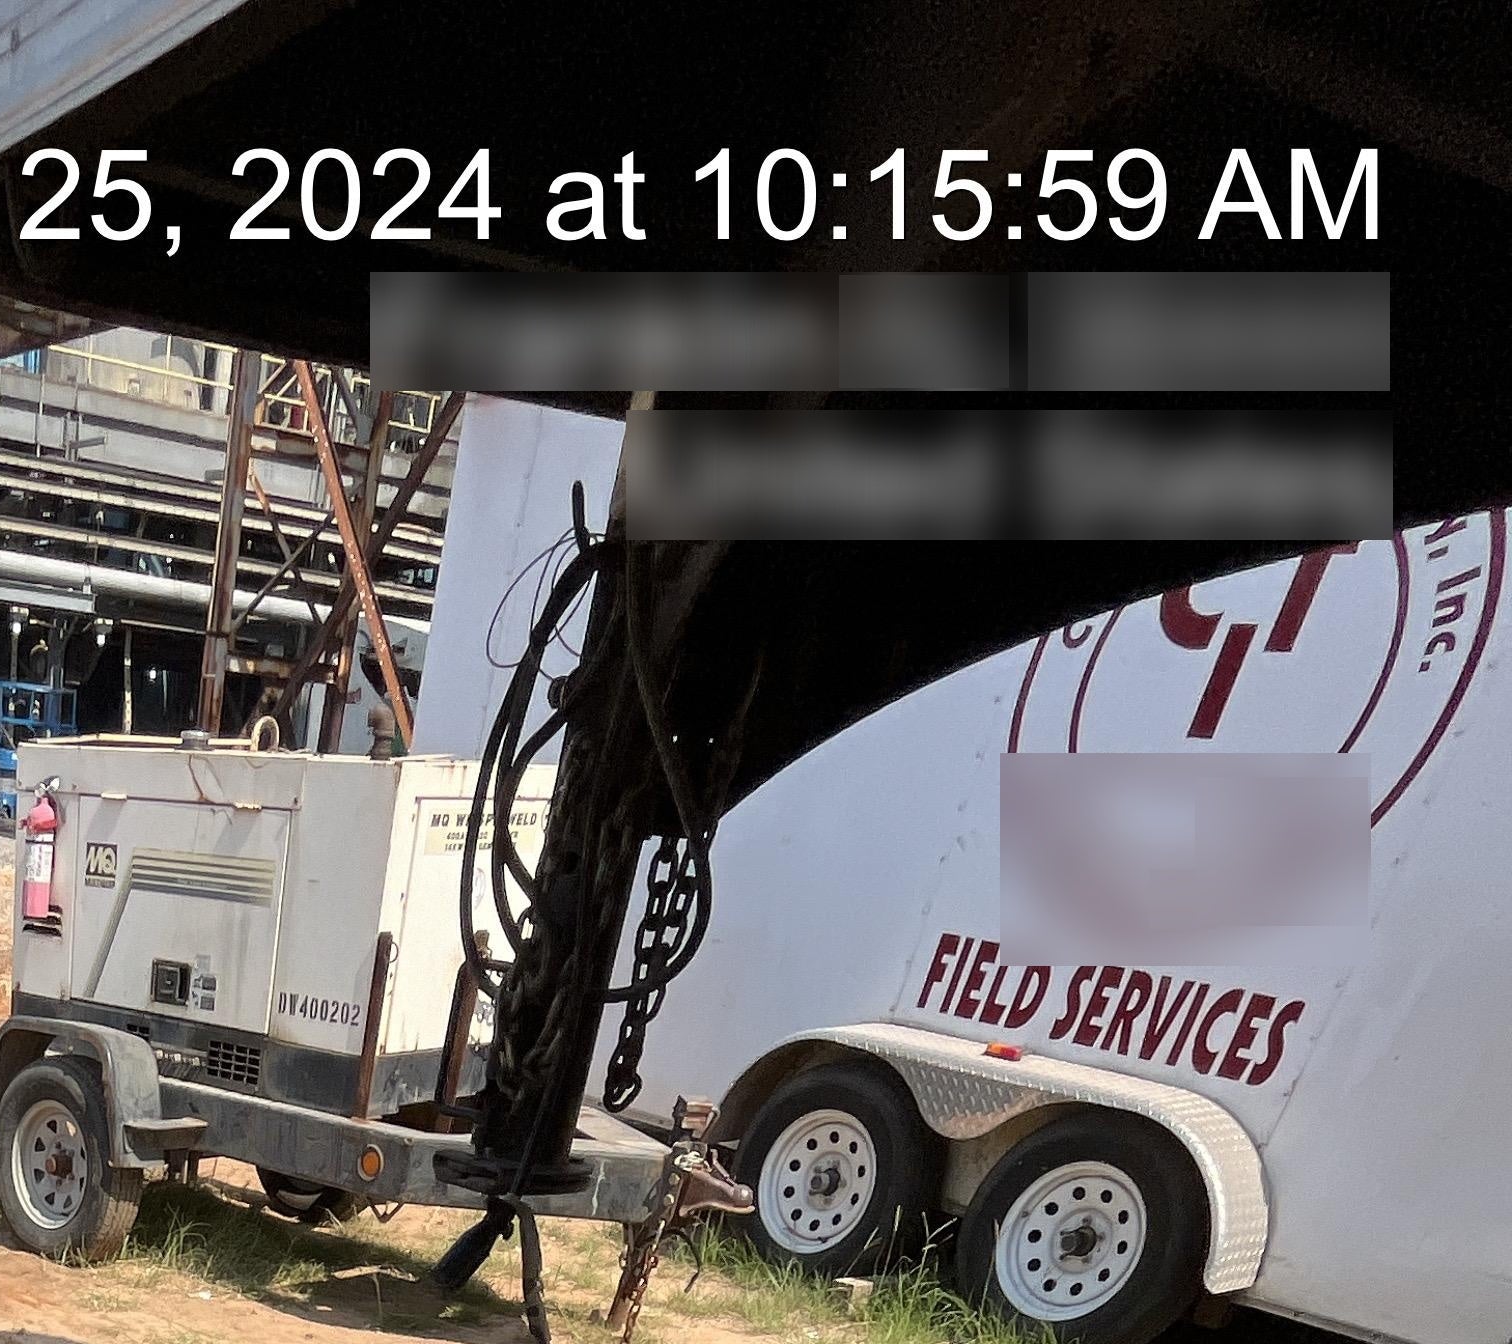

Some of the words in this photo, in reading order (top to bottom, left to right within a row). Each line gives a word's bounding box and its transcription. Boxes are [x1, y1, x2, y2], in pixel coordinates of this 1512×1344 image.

[1418, 565, 1482, 673] Inc.
[430, 813, 450, 828] MQ
[86, 845, 116, 875] MQ
[277, 991, 361, 1027] DW400202
[916, 932, 1052, 1029] FIELD
[1049, 965, 1306, 1086] SERVICES
